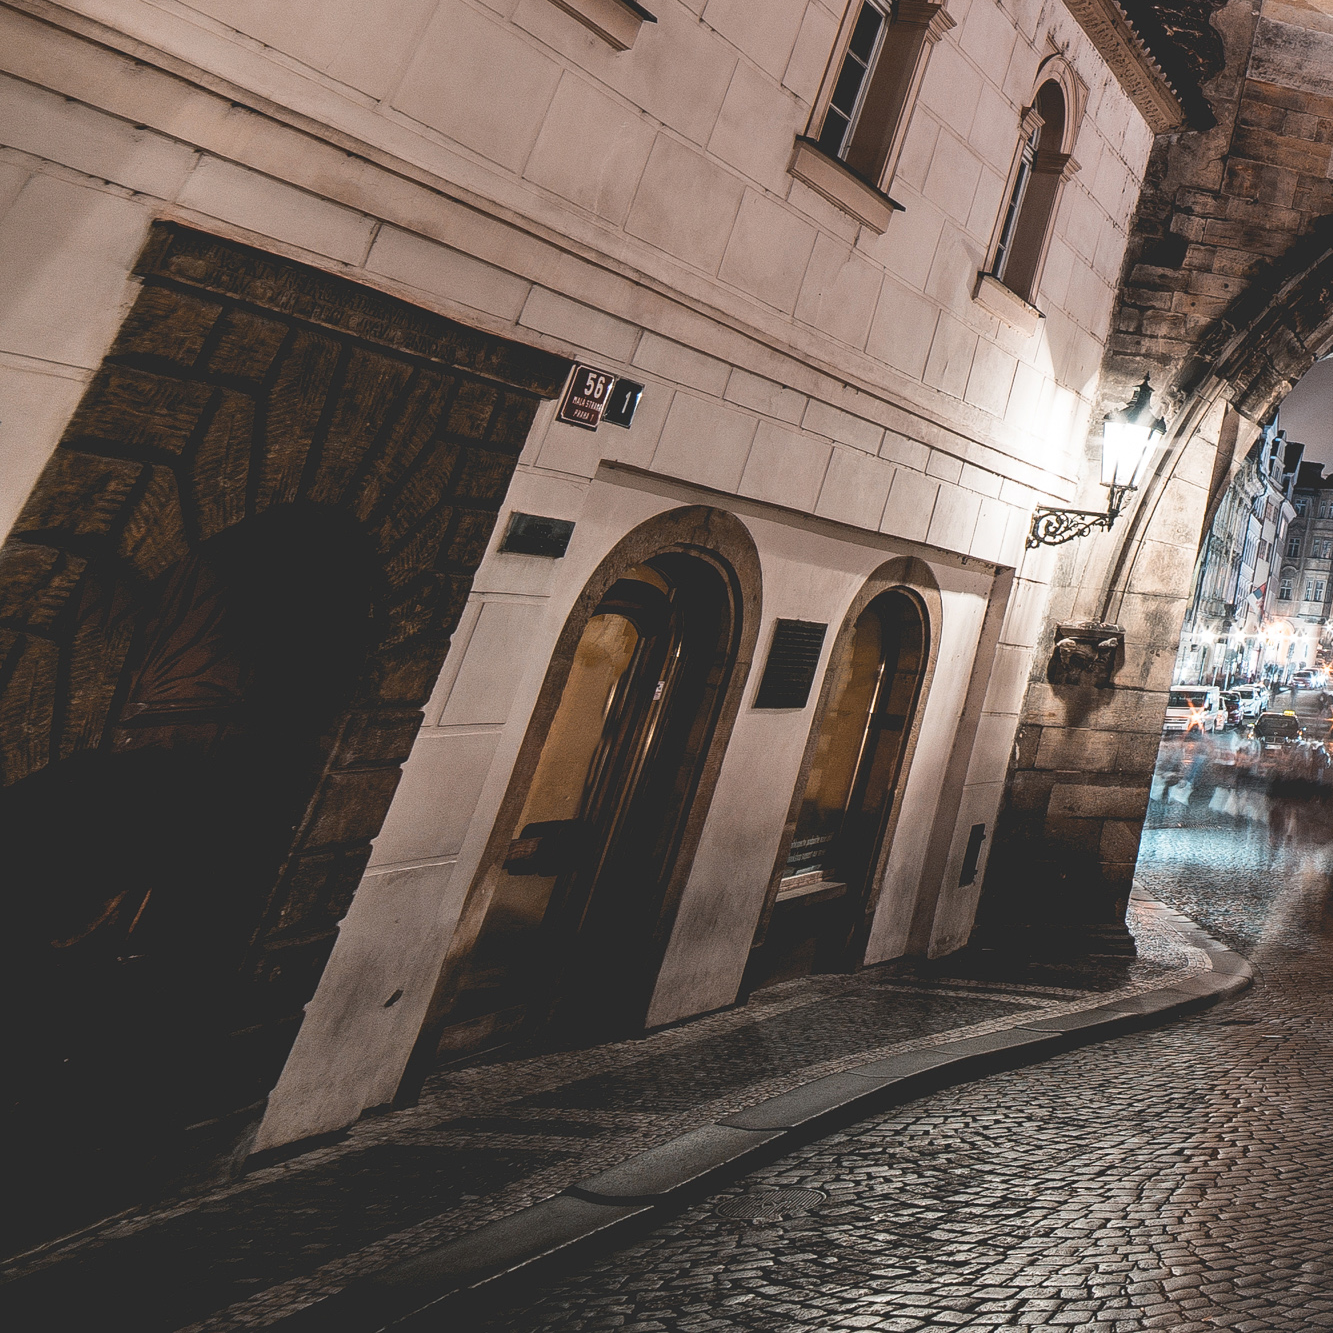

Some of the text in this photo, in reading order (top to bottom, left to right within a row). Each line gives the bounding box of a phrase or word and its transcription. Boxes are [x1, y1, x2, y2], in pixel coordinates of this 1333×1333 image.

[584, 372, 606, 399] 56
[621, 391, 632, 414] 1
[572, 409, 590, 420] PRAHA
